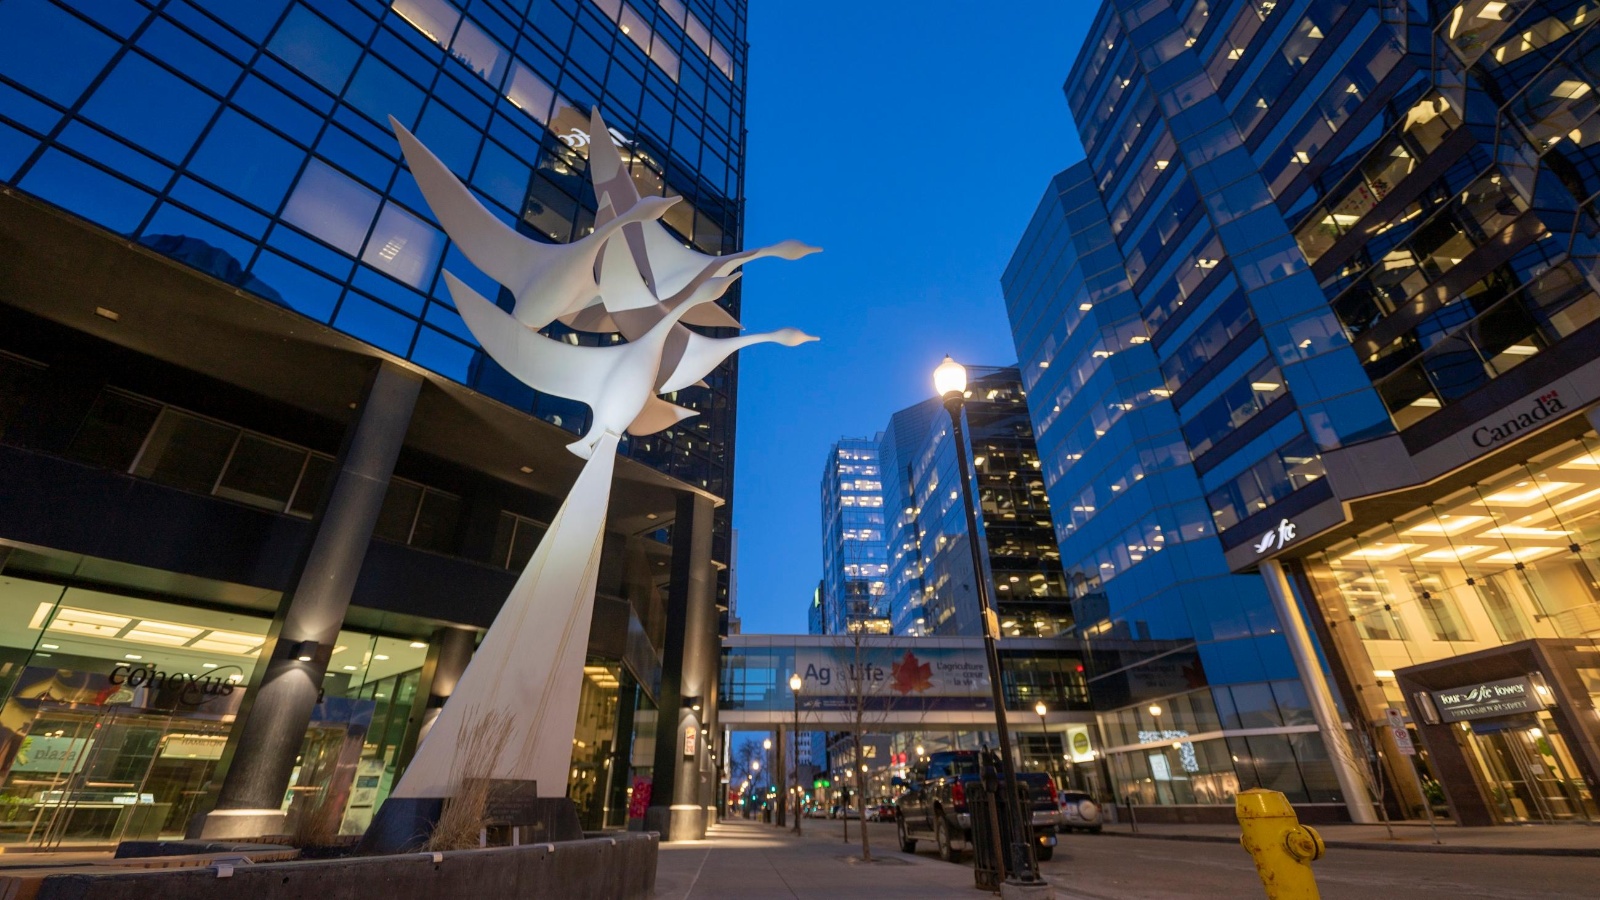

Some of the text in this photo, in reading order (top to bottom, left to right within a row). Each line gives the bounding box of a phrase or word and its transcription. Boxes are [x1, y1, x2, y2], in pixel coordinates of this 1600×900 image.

[1472, 398, 1567, 447] Canada
[109, 664, 243, 706] conexus
[804, 663, 831, 685] Ag
[849, 663, 884, 681] Life
[953, 677, 961, 686] la
[32, 746, 76, 763] plaza
